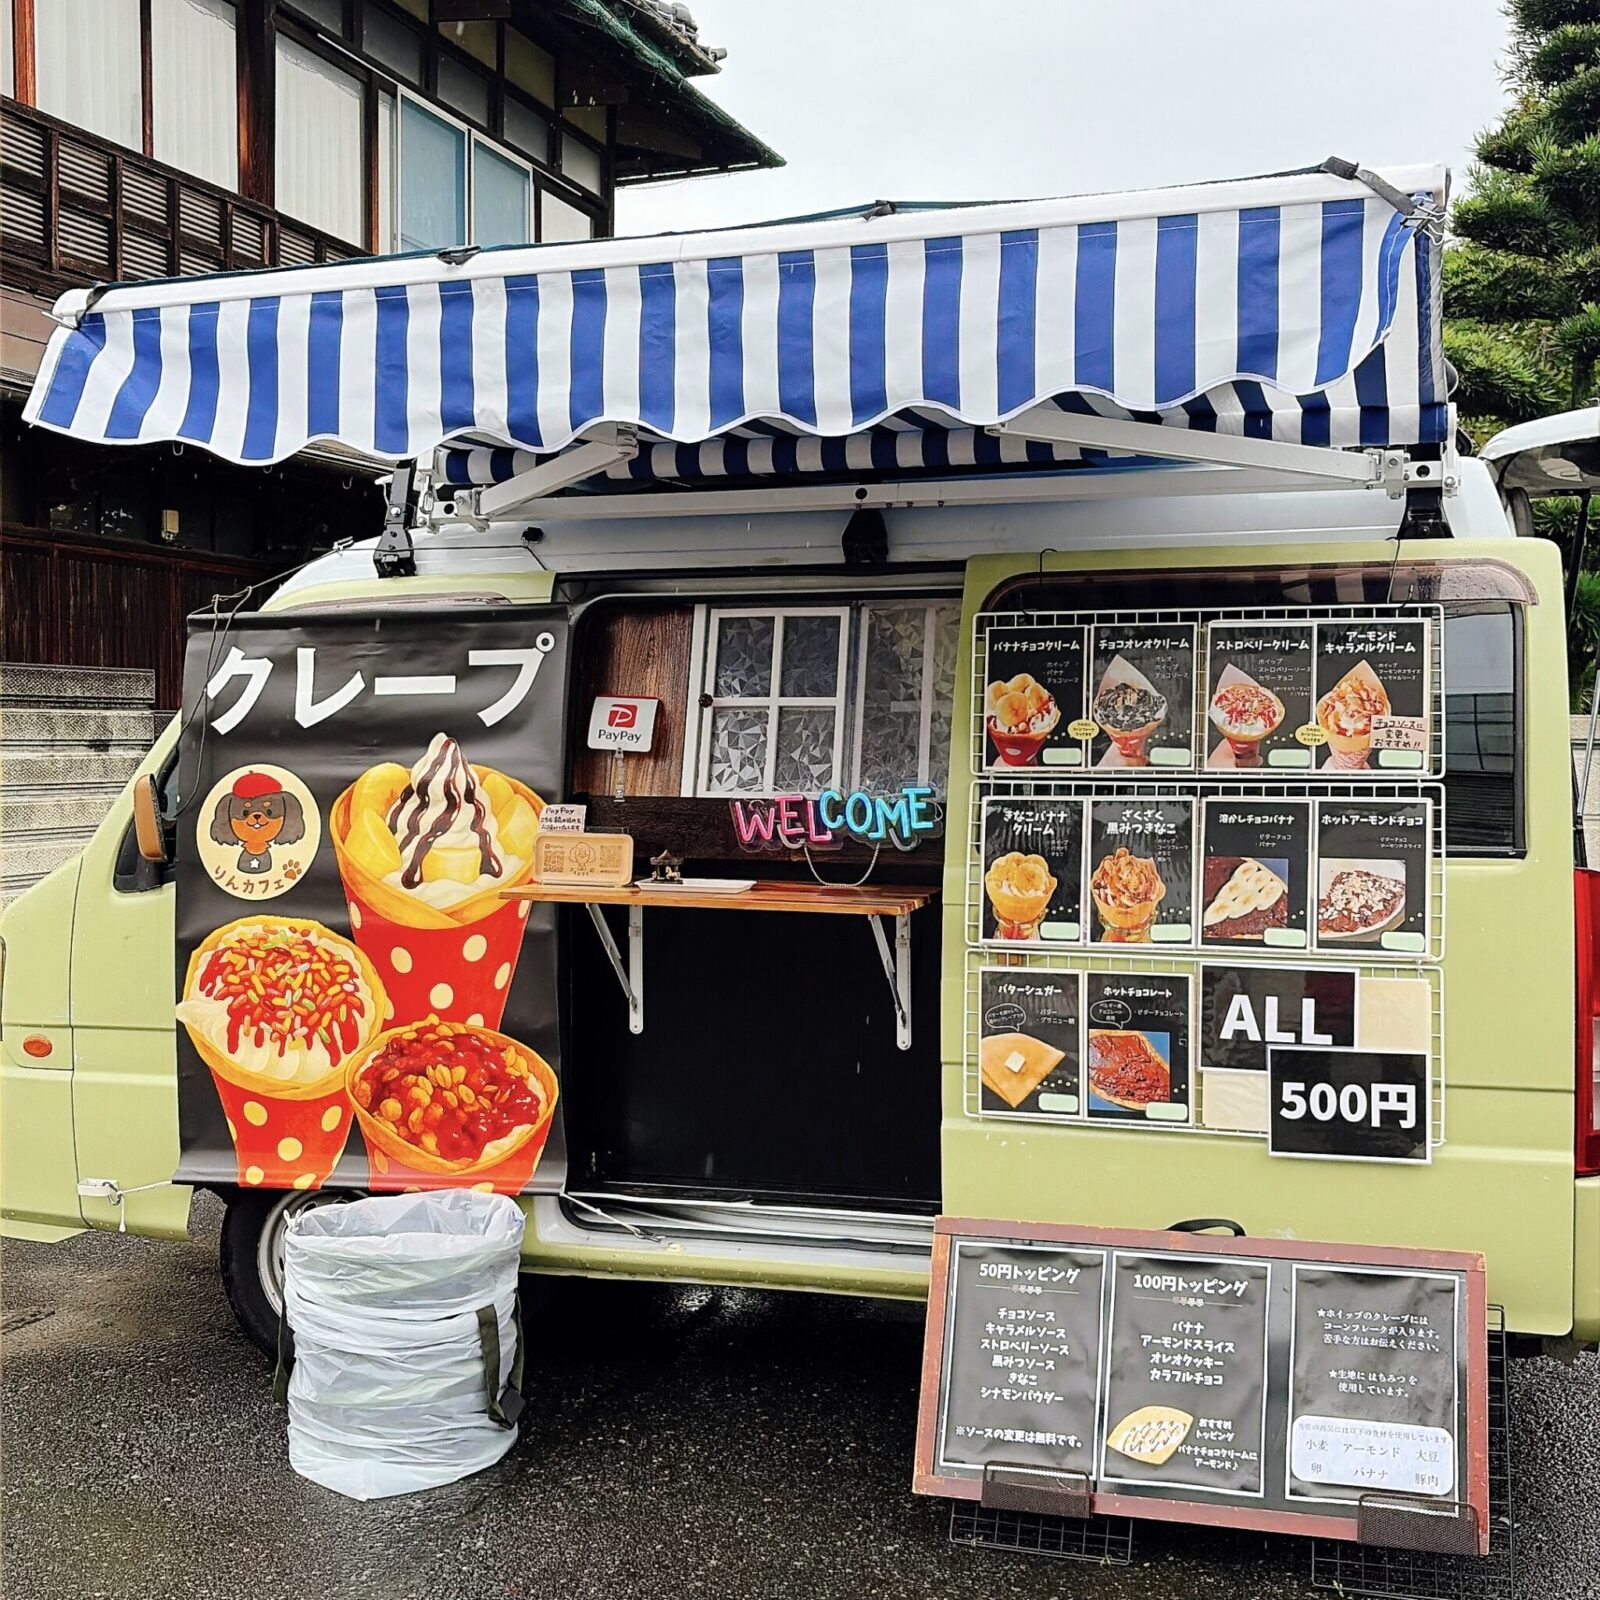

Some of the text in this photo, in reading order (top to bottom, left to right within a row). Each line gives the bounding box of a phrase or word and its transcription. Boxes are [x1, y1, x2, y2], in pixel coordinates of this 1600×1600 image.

[1346, 631, 1397, 641] アーモンド
[993, 640, 1080, 651] バナナチョコクリーム
[1098, 638, 1190, 650] チョコオレオクリーム
[1216, 639, 1310, 650] ストロベリークリーム
[1325, 641, 1416, 654] キャラメルクリーム
[206, 631, 555, 735] クレープ
[1376, 718, 1423, 729] チョコソースに
[598, 729, 641, 743] PayPay
[735, 787, 933, 842] WELCOME
[1003, 810, 1068, 823] きなこバナナ
[1121, 809, 1164, 821] ざくざく
[1218, 813, 1295, 825] 溶かしチョコバナナ
[1321, 814, 1423, 827] ホットアーモンドチョコ
[1012, 823, 1055, 836] クリーム
[1106, 822, 1176, 835] 黒みつきなこ
[214, 865, 284, 894] りんカフェ
[998, 984, 1062, 995] バターシュガー
[1103, 986, 1173, 998] ホットチョコレート
[1219, 994, 1333, 1045] ALL
[1279, 1082, 1416, 1129] 500円
[979, 1263, 1081, 1285] 50円トッピング
[1133, 1274, 1248, 1297] 100円トッピング
[997, 1307, 1056, 1322] チョコソース
[985, 1322, 1066, 1339] キャラメルソース
[1172, 1321, 1205, 1335] バナナ
[1323, 1322, 1440, 1339] コーンフレークが入ります。
[980, 1339, 1070, 1356] ストロベリーソース
[1140, 1334, 1236, 1354] アーモンドスライス
[1323, 1333, 1440, 1352] 苦手な方はお伝えください。
[991, 1354, 1056, 1370] 黒みつソース
[1149, 1352, 1224, 1369] オレオクッキー
[1007, 1372, 1038, 1386] きなこ
[1149, 1368, 1224, 1386] カラフルチョコ
[980, 1386, 1064, 1404] シナモンパウダー
[1338, 1383, 1409, 1398] 使用しています。
[1199, 1418, 1232, 1430] おすすめ
[1195, 1429, 1235, 1443] トッピング
[1177, 1444, 1258, 1461] バナナチョコクリームに
[1305, 1439, 1439, 1463] 小麦 アーモンド 大豆
[1354, 1467, 1389, 1480] バナナ
[1415, 1472, 1439, 1487] 豚肉
